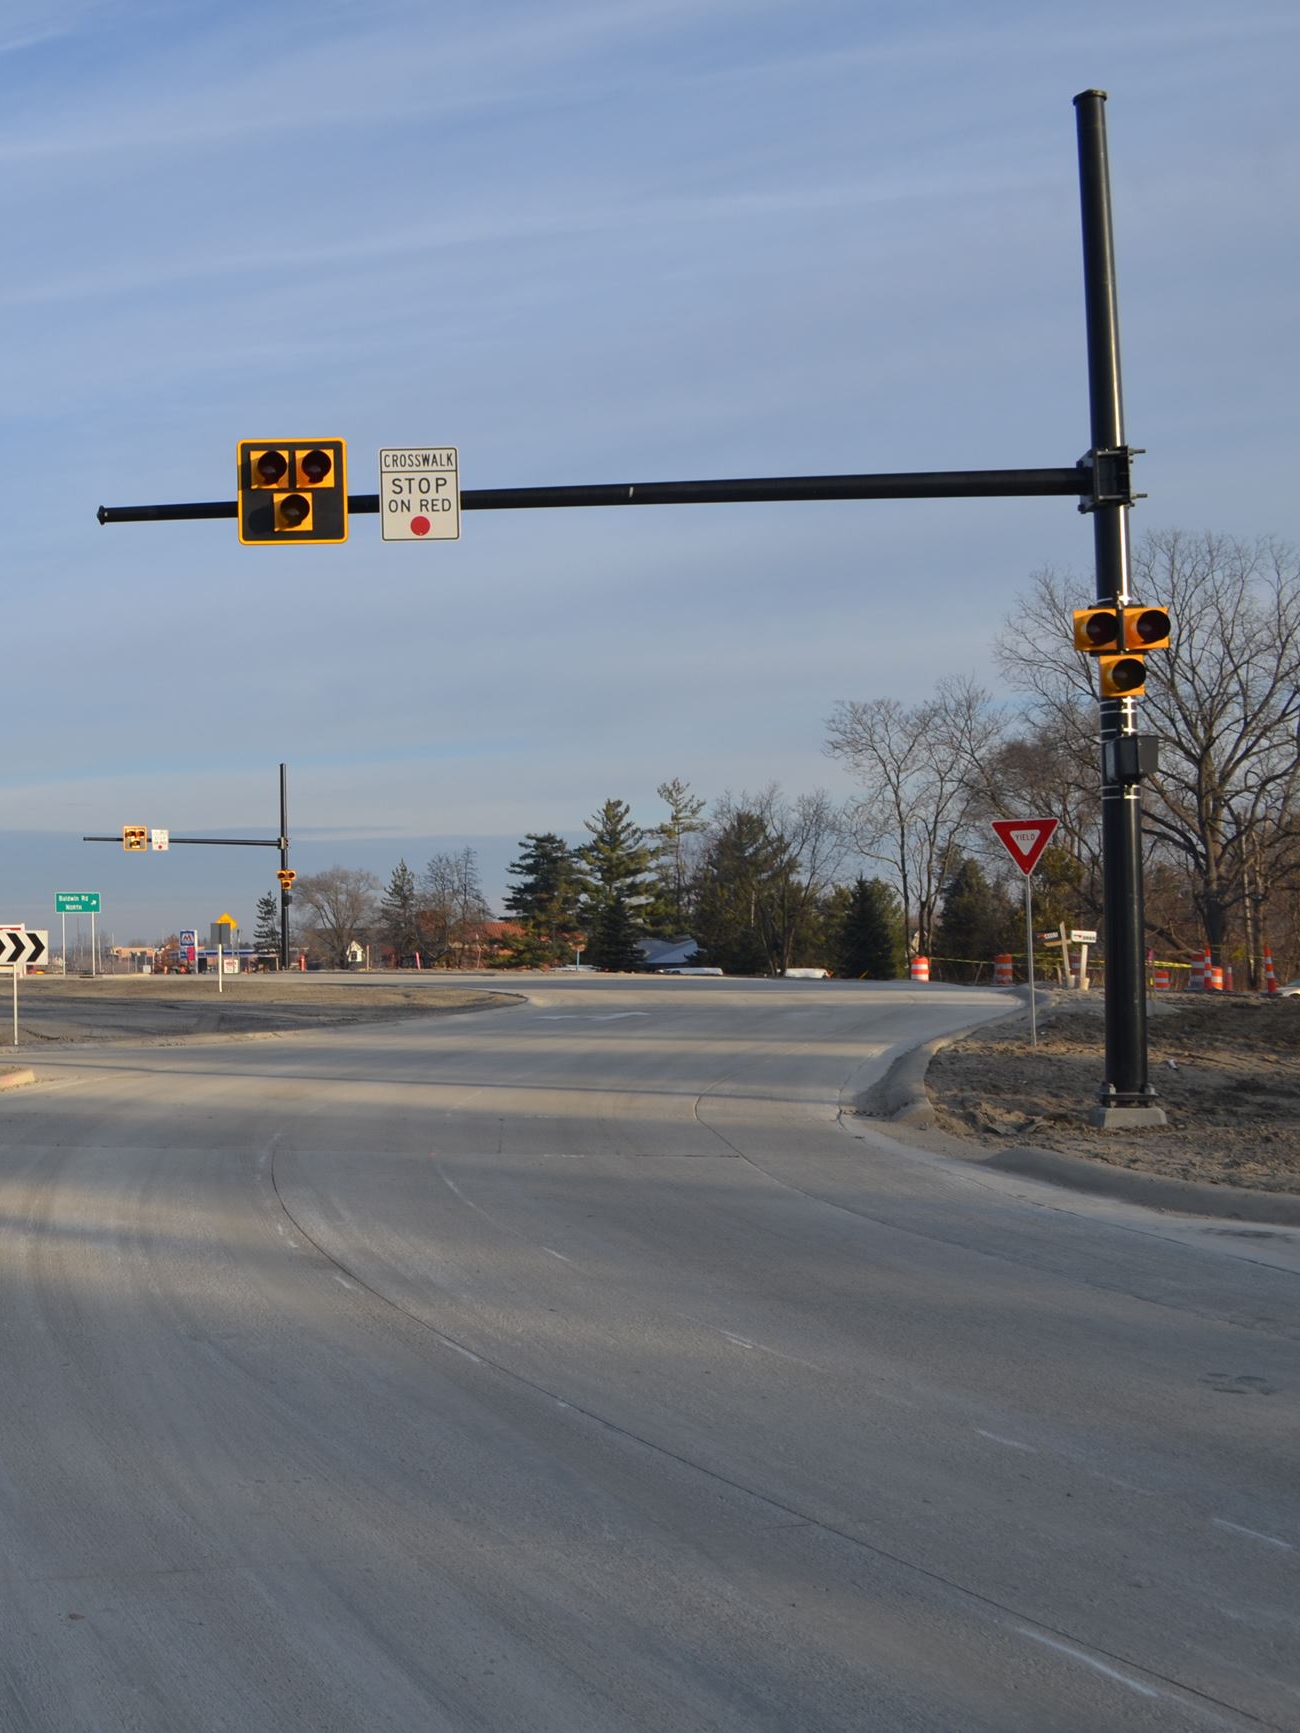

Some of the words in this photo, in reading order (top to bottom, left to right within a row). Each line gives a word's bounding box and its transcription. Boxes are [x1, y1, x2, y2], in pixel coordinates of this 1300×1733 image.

[384, 453, 454, 468] CROSSWALK
[391, 477, 448, 495] STOP
[388, 499, 411, 513] ON
[419, 498, 452, 513] RED
[1014, 833, 1036, 841] YIELD
